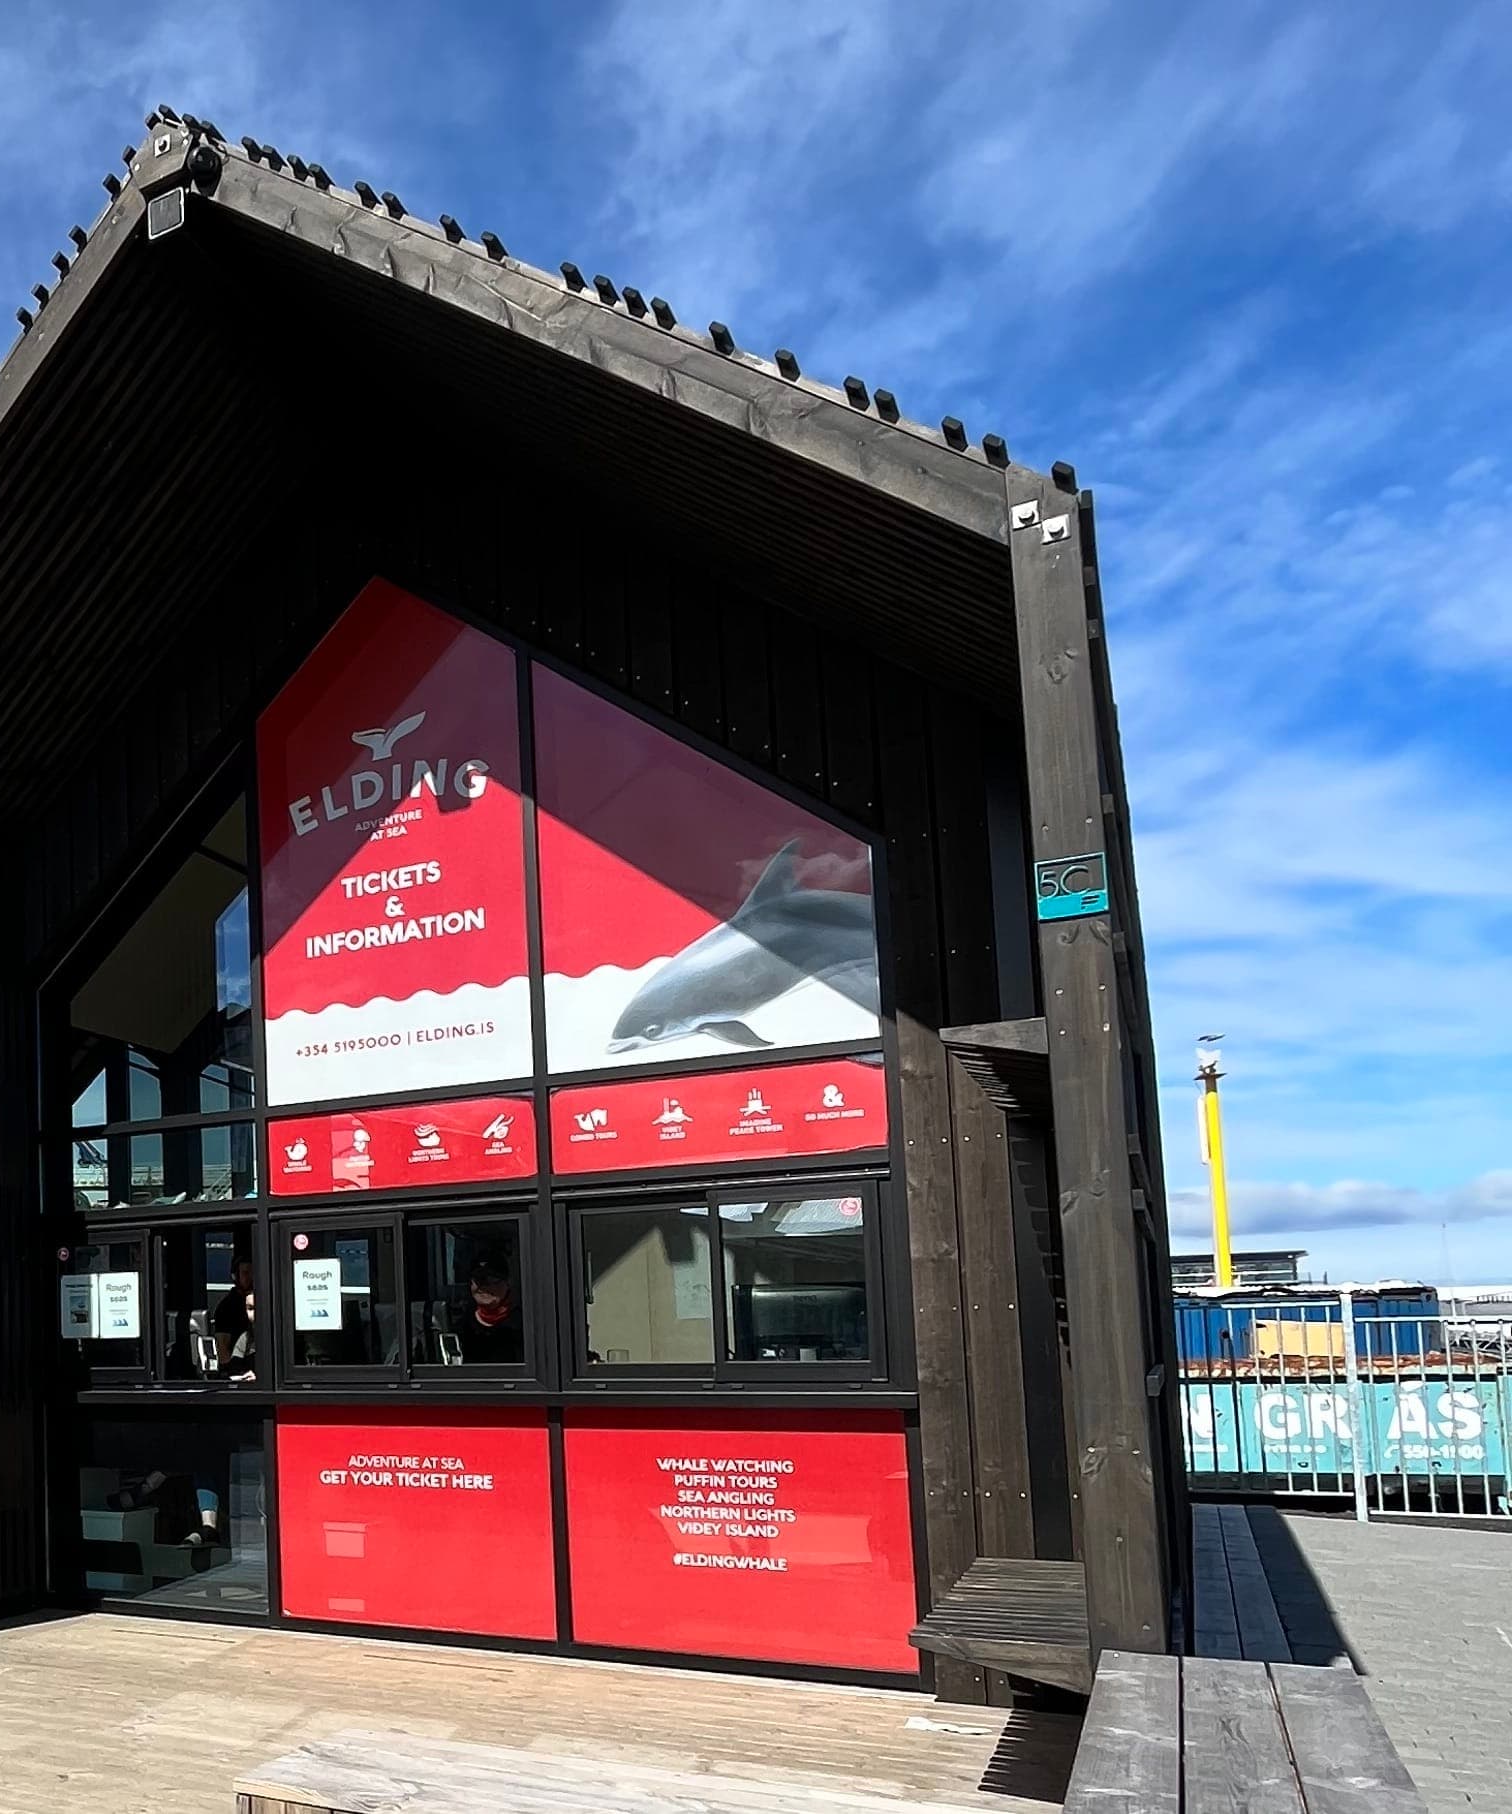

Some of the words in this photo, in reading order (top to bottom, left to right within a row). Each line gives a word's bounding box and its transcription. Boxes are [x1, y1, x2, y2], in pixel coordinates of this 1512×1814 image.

[289, 759, 490, 836] ELDING
[355, 809, 422, 832] ADVENTURE
[370, 830, 384, 842] AT
[386, 825, 407, 839] SEA
[341, 861, 441, 898] TICKETS
[384, 896, 405, 917] &
[306, 907, 485, 958] INFORMATION
[296, 1044, 328, 1057] +354
[334, 1034, 402, 1053] 5195000
[416, 1021, 495, 1043] ELDING.IS
[303, 1270, 333, 1281] Rough
[348, 1455, 420, 1469] ADVENTURE
[422, 1457, 438, 1469] AT
[441, 1457, 465, 1470] SEA
[656, 1458, 709, 1471] WHALE
[710, 1459, 794, 1474] WATCHING
[320, 1470, 348, 1485] GET
[350, 1471, 393, 1486] YOUR
[395, 1472, 449, 1489] TICKET
[451, 1474, 494, 1490] HERE
[674, 1474, 725, 1488] PUFFIN
[727, 1475, 778, 1489] TOURS
[677, 1489, 706, 1503] SEA
[706, 1491, 775, 1505] ANGLING
[660, 1504, 741, 1520] NORTHERN
[743, 1508, 797, 1523] LIGHTS
[677, 1521, 722, 1535] VIDEY
[725, 1523, 779, 1538] ISLAND
[673, 1552, 788, 1572] #ELDINGWHALE
